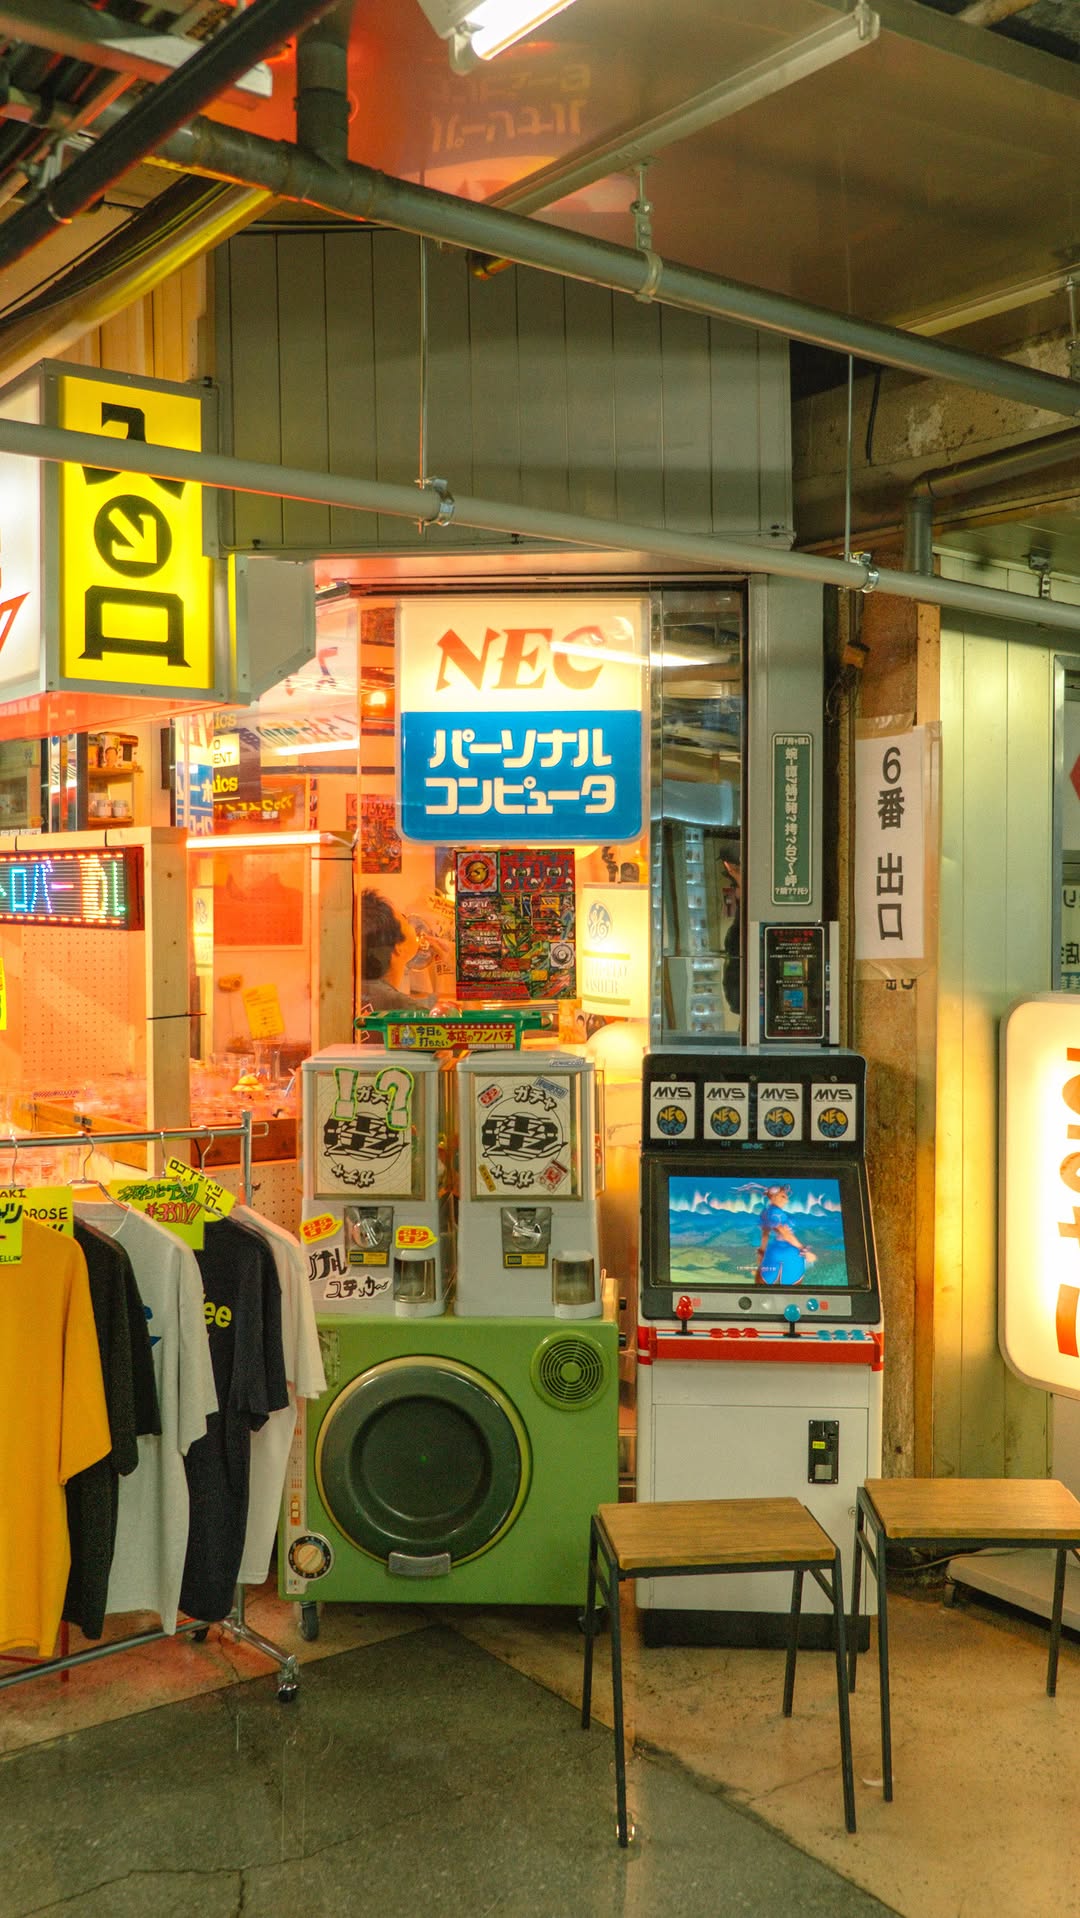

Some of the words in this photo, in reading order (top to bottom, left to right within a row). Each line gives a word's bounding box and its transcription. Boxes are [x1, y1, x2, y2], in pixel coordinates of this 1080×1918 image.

[435, 625, 607, 692] NEC
[428, 728, 613, 769] パーソナル
[424, 774, 616, 815] コンピュータ
[877, 745, 905, 830] 6番
[875, 852, 905, 942] 出口
[356, 1085, 391, 1107] ガチ
[514, 1083, 558, 1112] ガチャ
[652, 1086, 692, 1098] MVS
[706, 1087, 746, 1099] MVS
[760, 1088, 799, 1100] MVS
[813, 1088, 853, 1100] MVS
[660, 1106, 685, 1123] NEO
[714, 1107, 739, 1124] NEO
[767, 1108, 793, 1125] NEO
[820, 1108, 846, 1125] NEO
[24, 1207, 68, 1220] ROSE
